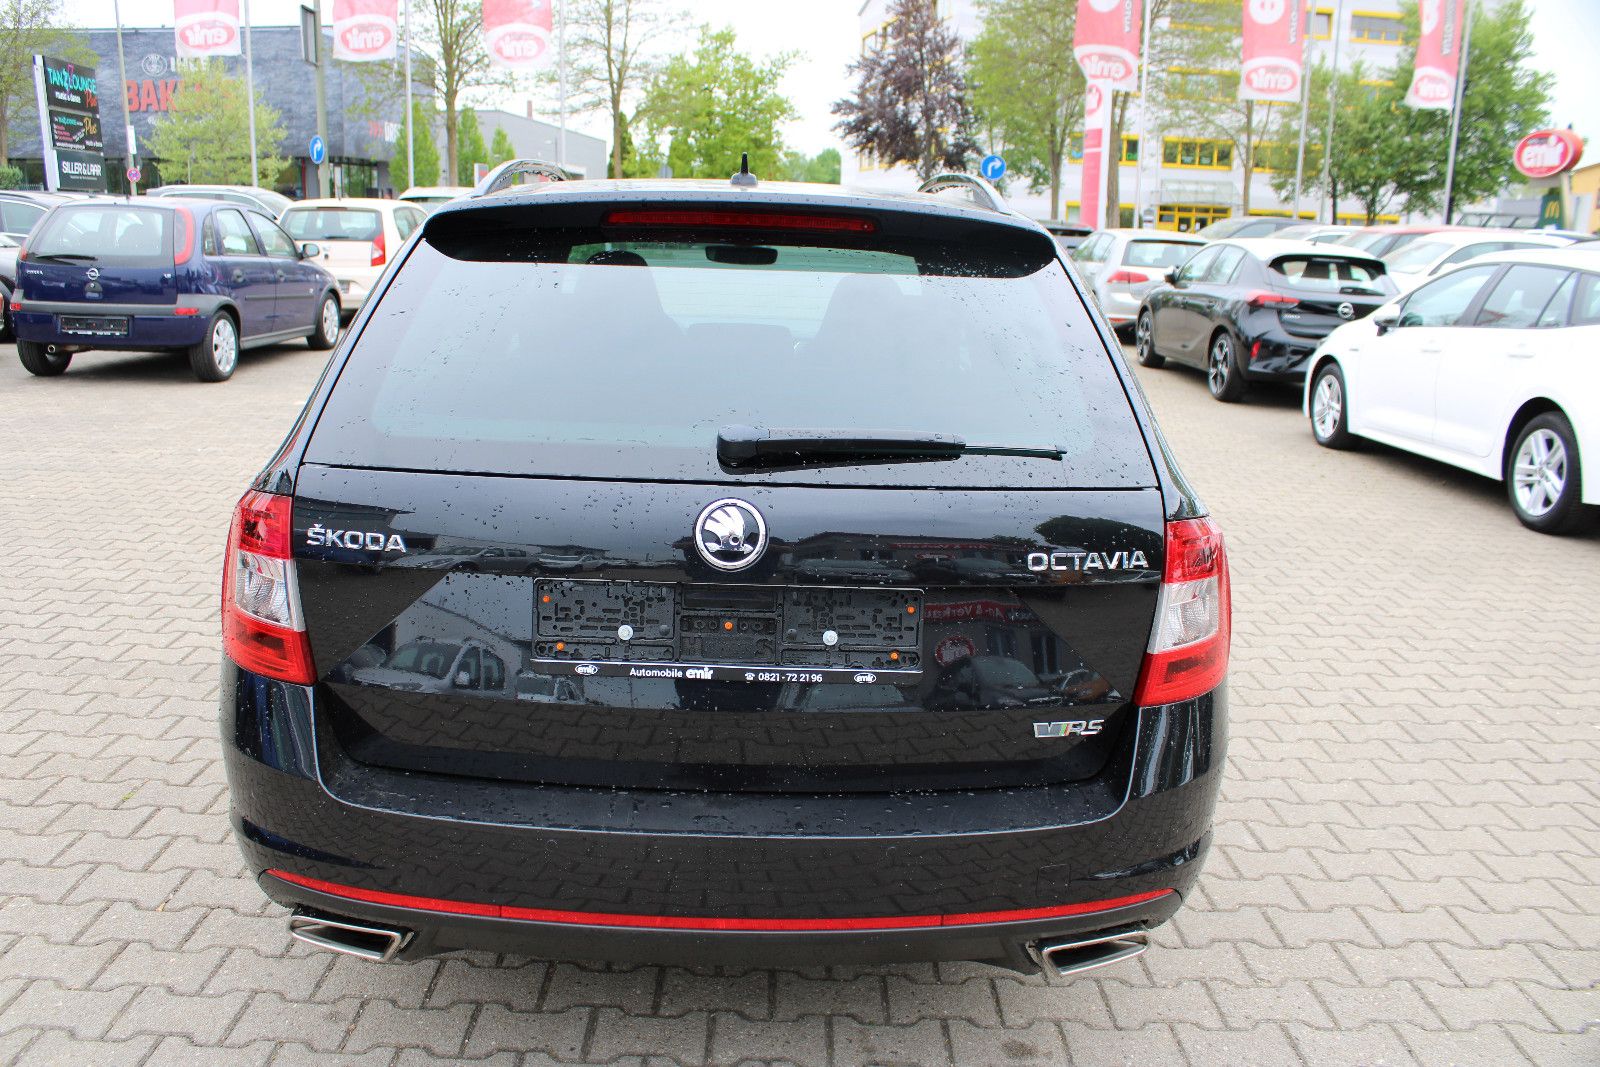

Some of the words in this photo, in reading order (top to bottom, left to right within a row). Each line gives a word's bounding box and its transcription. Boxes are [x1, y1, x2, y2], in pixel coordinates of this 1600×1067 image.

[1522, 134, 1565, 168] emir
[306, 523, 407, 553] ŠKODA
[1027, 550, 1149, 571] OCTAVIA
[577, 665, 596, 675] emir
[629, 667, 683, 678] Automobile
[686, 666, 713, 680] emir
[856, 673, 874, 683] emir
